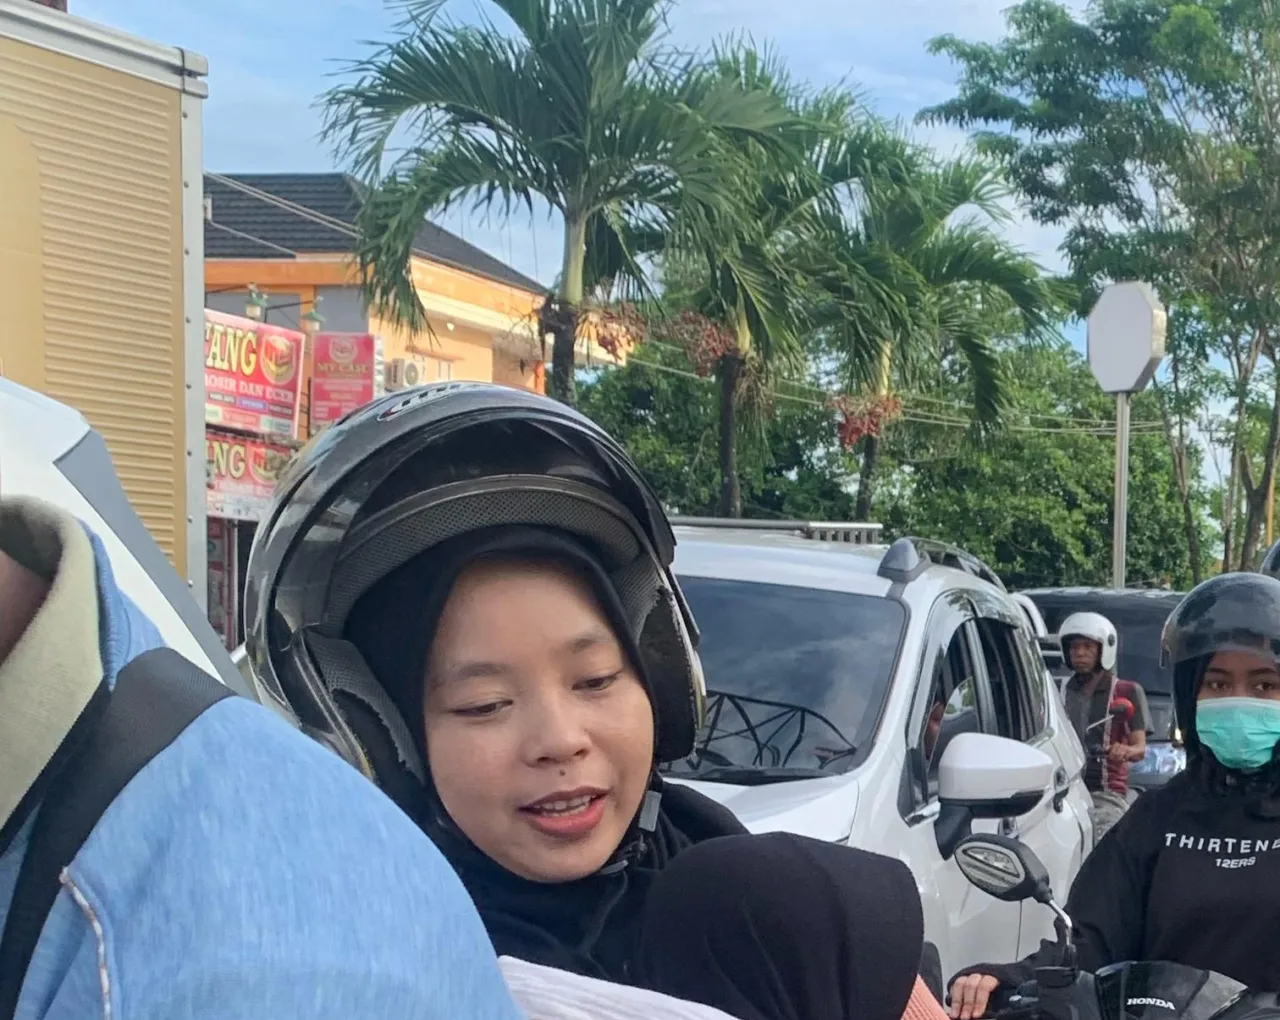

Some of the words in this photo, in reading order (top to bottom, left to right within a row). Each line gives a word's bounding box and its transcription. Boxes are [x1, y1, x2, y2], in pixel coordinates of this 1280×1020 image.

[239, 380, 264, 398] DAN
[206, 440, 246, 479] NG
[1215, 857, 1256, 869] 12ERS
[1126, 998, 1176, 1010] HONDA
